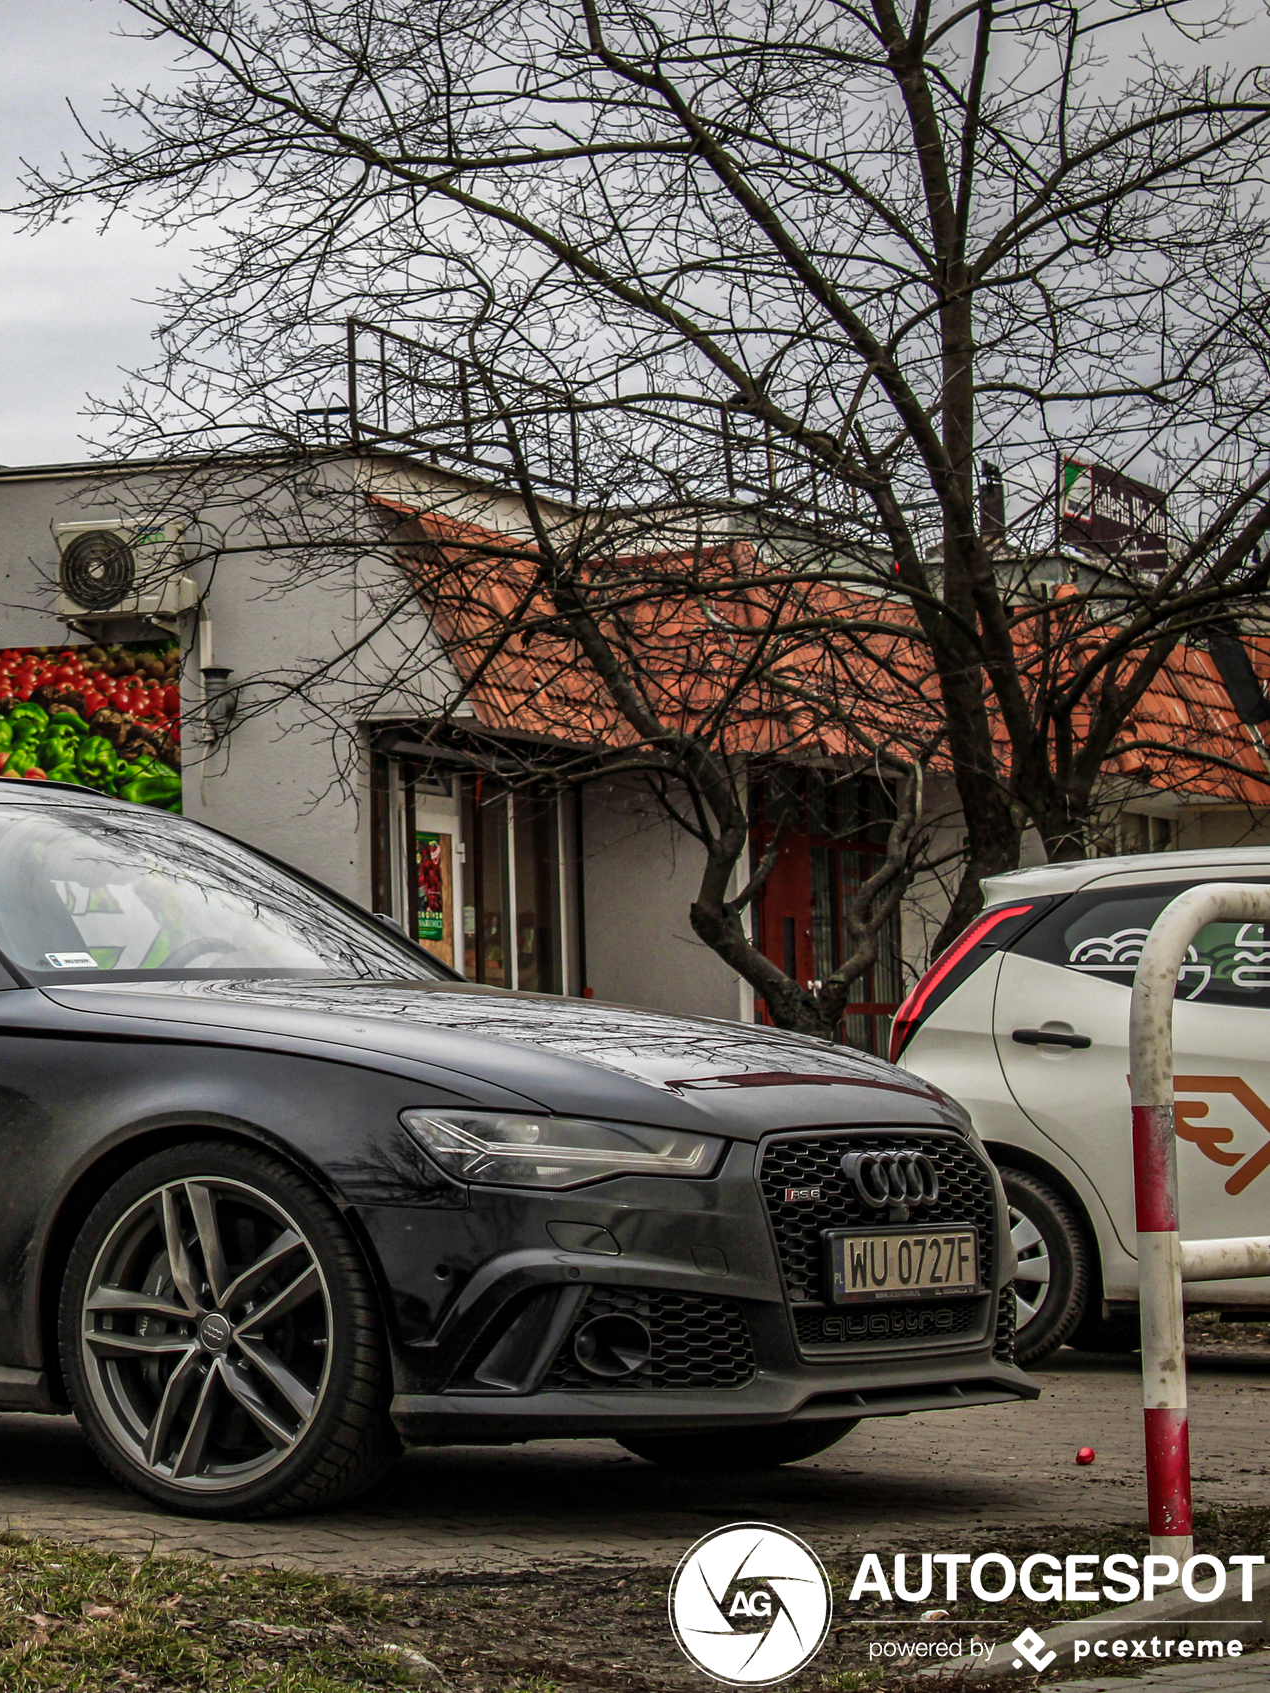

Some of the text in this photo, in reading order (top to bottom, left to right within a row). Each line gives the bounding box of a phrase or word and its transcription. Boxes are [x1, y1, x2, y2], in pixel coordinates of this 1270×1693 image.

[834, 1272, 844, 1285] PL
[848, 1234, 972, 1289] WU 0727F
[822, 1308, 953, 1342] quattro
